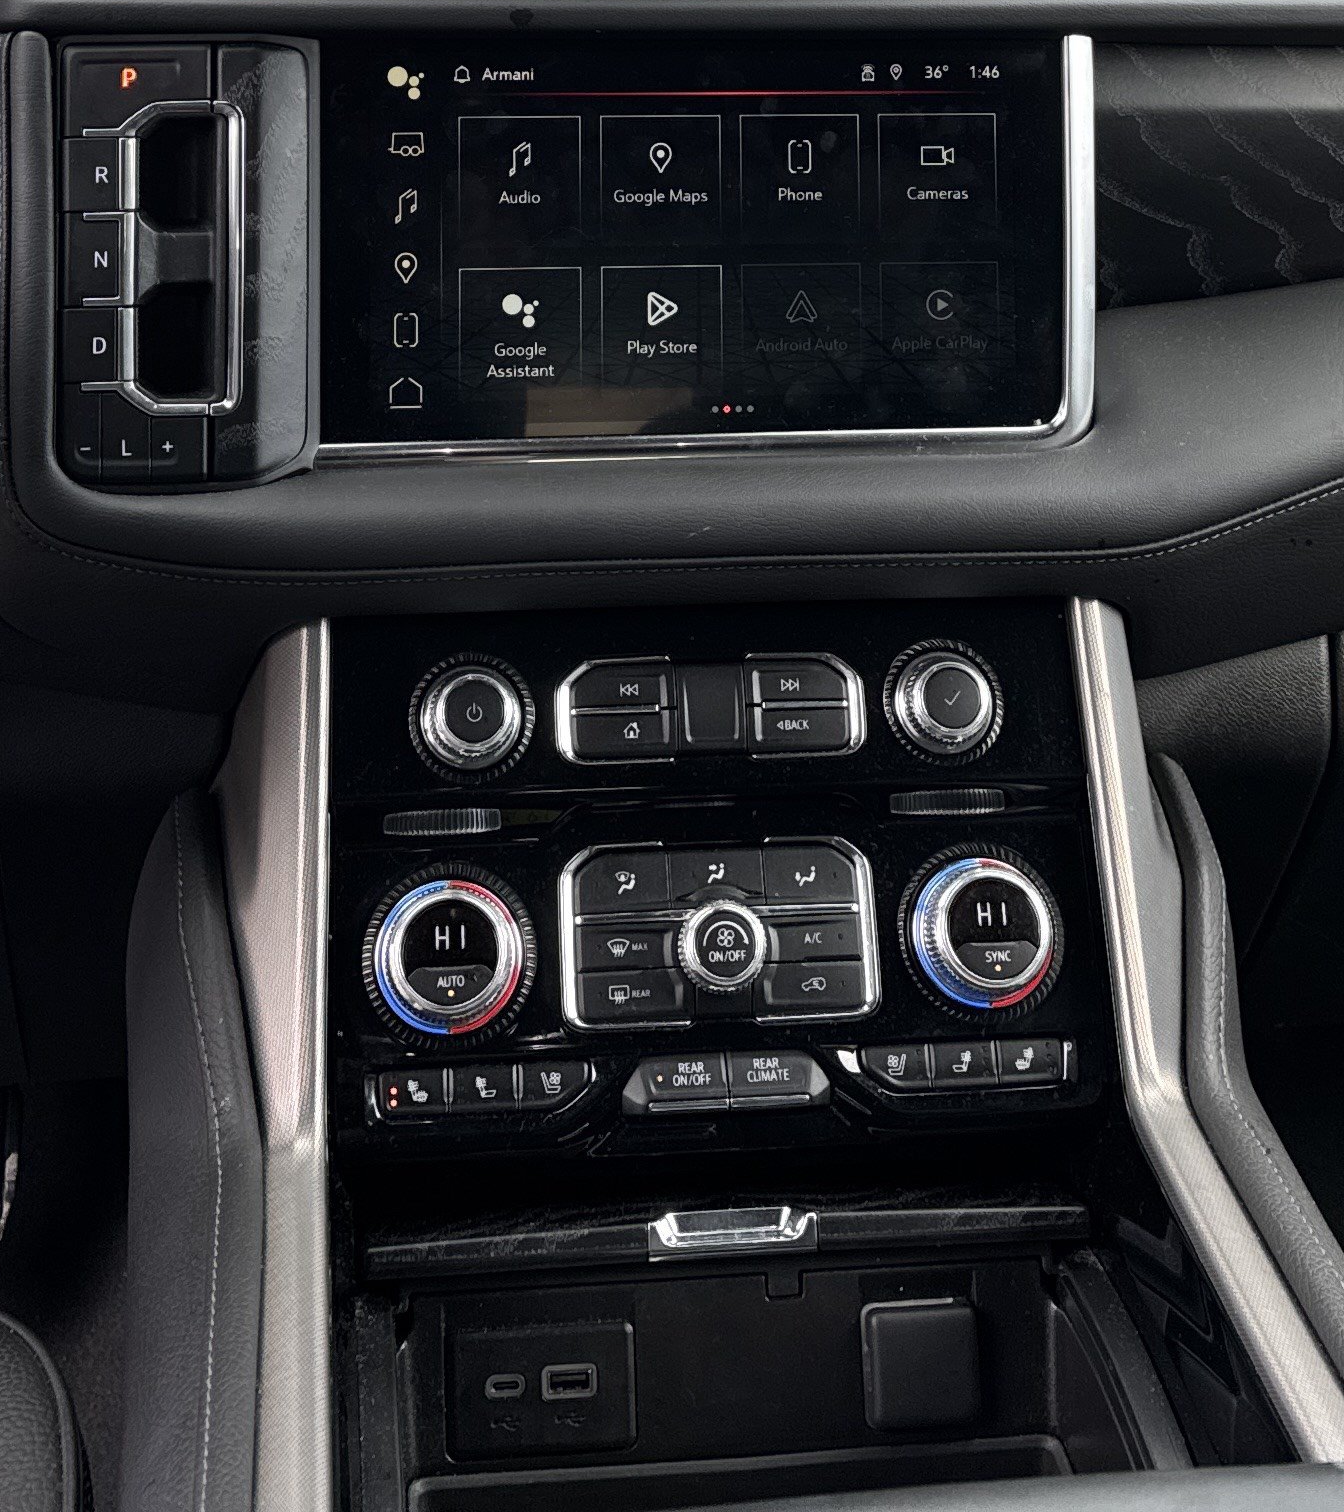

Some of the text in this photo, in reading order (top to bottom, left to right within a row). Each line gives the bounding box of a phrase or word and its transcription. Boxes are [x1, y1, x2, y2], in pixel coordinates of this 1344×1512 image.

[120, 67, 137, 87] P
[481, 67, 534, 81] Armani
[924, 64, 949, 79] 36°
[969, 65, 1000, 79] 1:46
[94, 166, 109, 184] R
[498, 189, 541, 204] Audio
[613, 188, 708, 207] Google Maps
[778, 187, 823, 201] Phone
[906, 186, 969, 200] Cameras
[93, 251, 108, 268] N
[92, 337, 107, 355] D
[494, 341, 547, 360] Google
[627, 339, 698, 358] Play Store
[755, 337, 848, 352] Android Auto
[891, 335, 988, 354] Apple CarPlay
[487, 364, 555, 378] Assistant
[121, 439, 132, 456] L
[784, 719, 810, 730] BACK
[976, 901, 1007, 927] HI
[434, 924, 466, 951] HI
[804, 932, 823, 944] A/C
[631, 941, 649, 951] MAX
[708, 949, 747, 963] ON/OFF
[984, 950, 1012, 963] SYNC
[436, 975, 465, 988] AUTO
[631, 988, 651, 998] REAR
[678, 1061, 705, 1074] REAR
[752, 1057, 779, 1070] REAR
[672, 1072, 712, 1086] ON/OFF
[747, 1068, 789, 1083] CLIMATE
